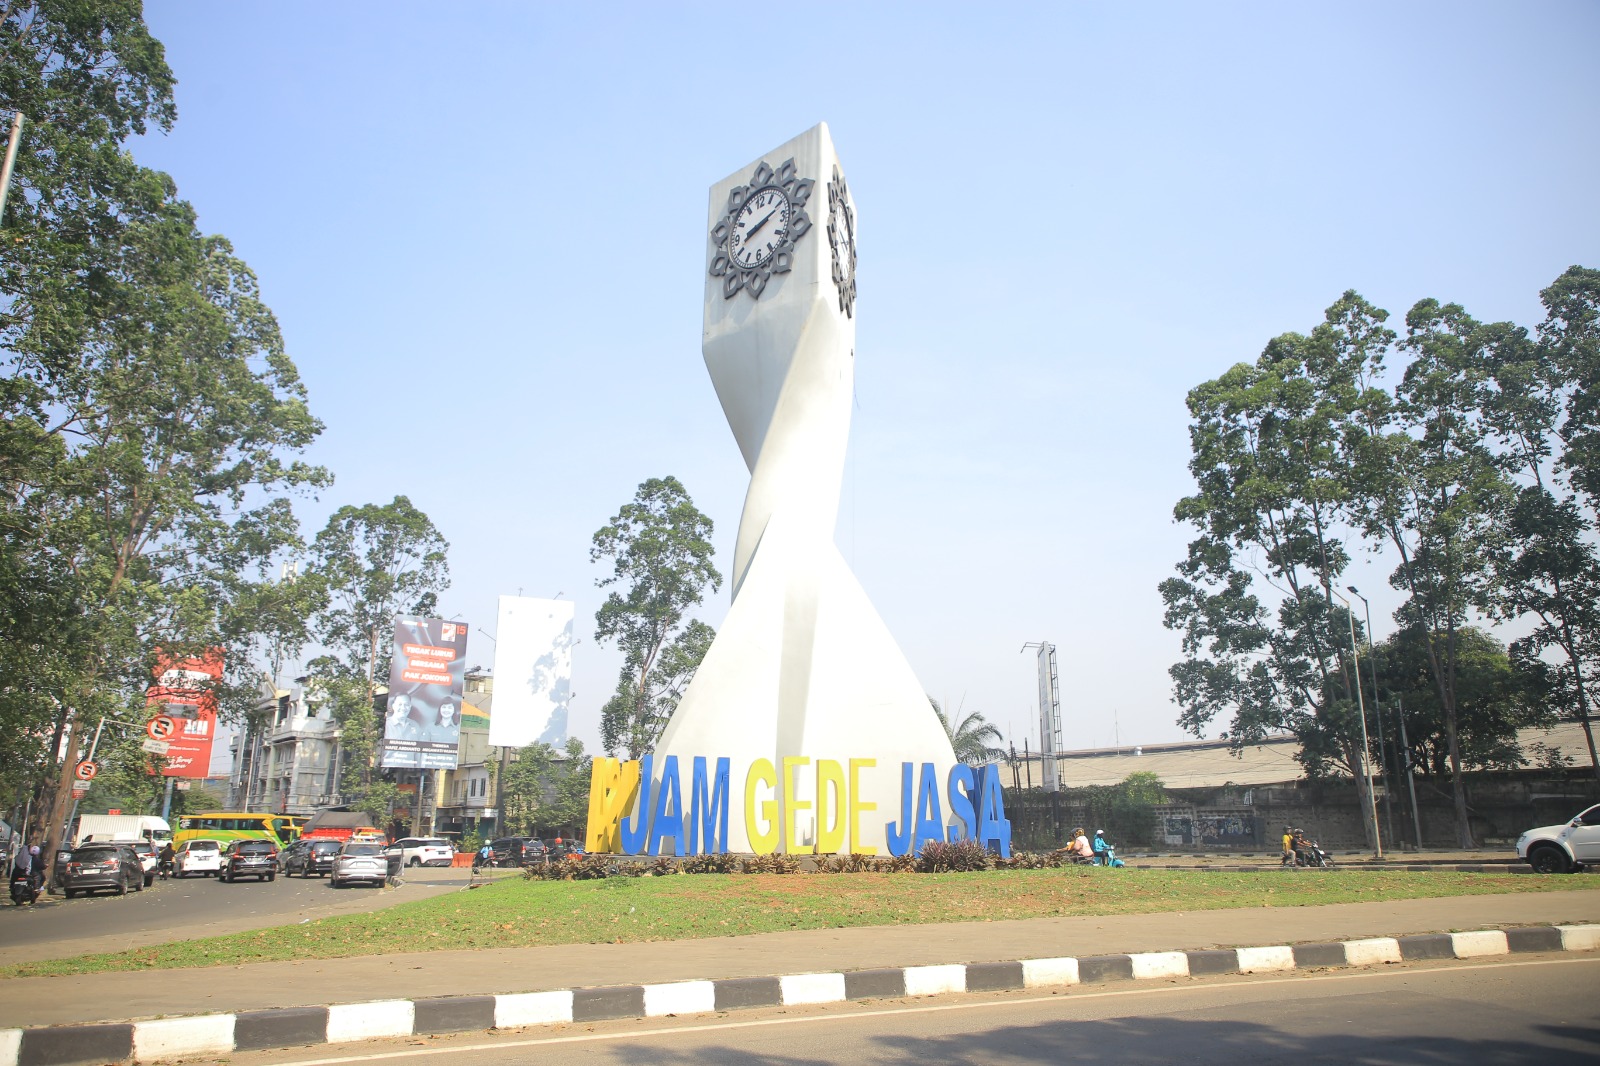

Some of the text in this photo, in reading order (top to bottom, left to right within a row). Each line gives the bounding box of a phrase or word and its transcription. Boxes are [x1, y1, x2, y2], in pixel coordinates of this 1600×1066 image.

[755, 196, 765, 209] 12
[779, 210, 786, 222] 3
[735, 234, 740, 246] 9
[756, 249, 762, 261] 6
[456, 625, 466, 635] 15
[406, 646, 430, 655] TEGAK
[410, 660, 445, 669] BERSAMA
[404, 671, 450, 682] PAK JOKOWI
[620, 754, 731, 857] JAM
[744, 756, 878, 857] GEDE
[885, 762, 1011, 859] JASA
